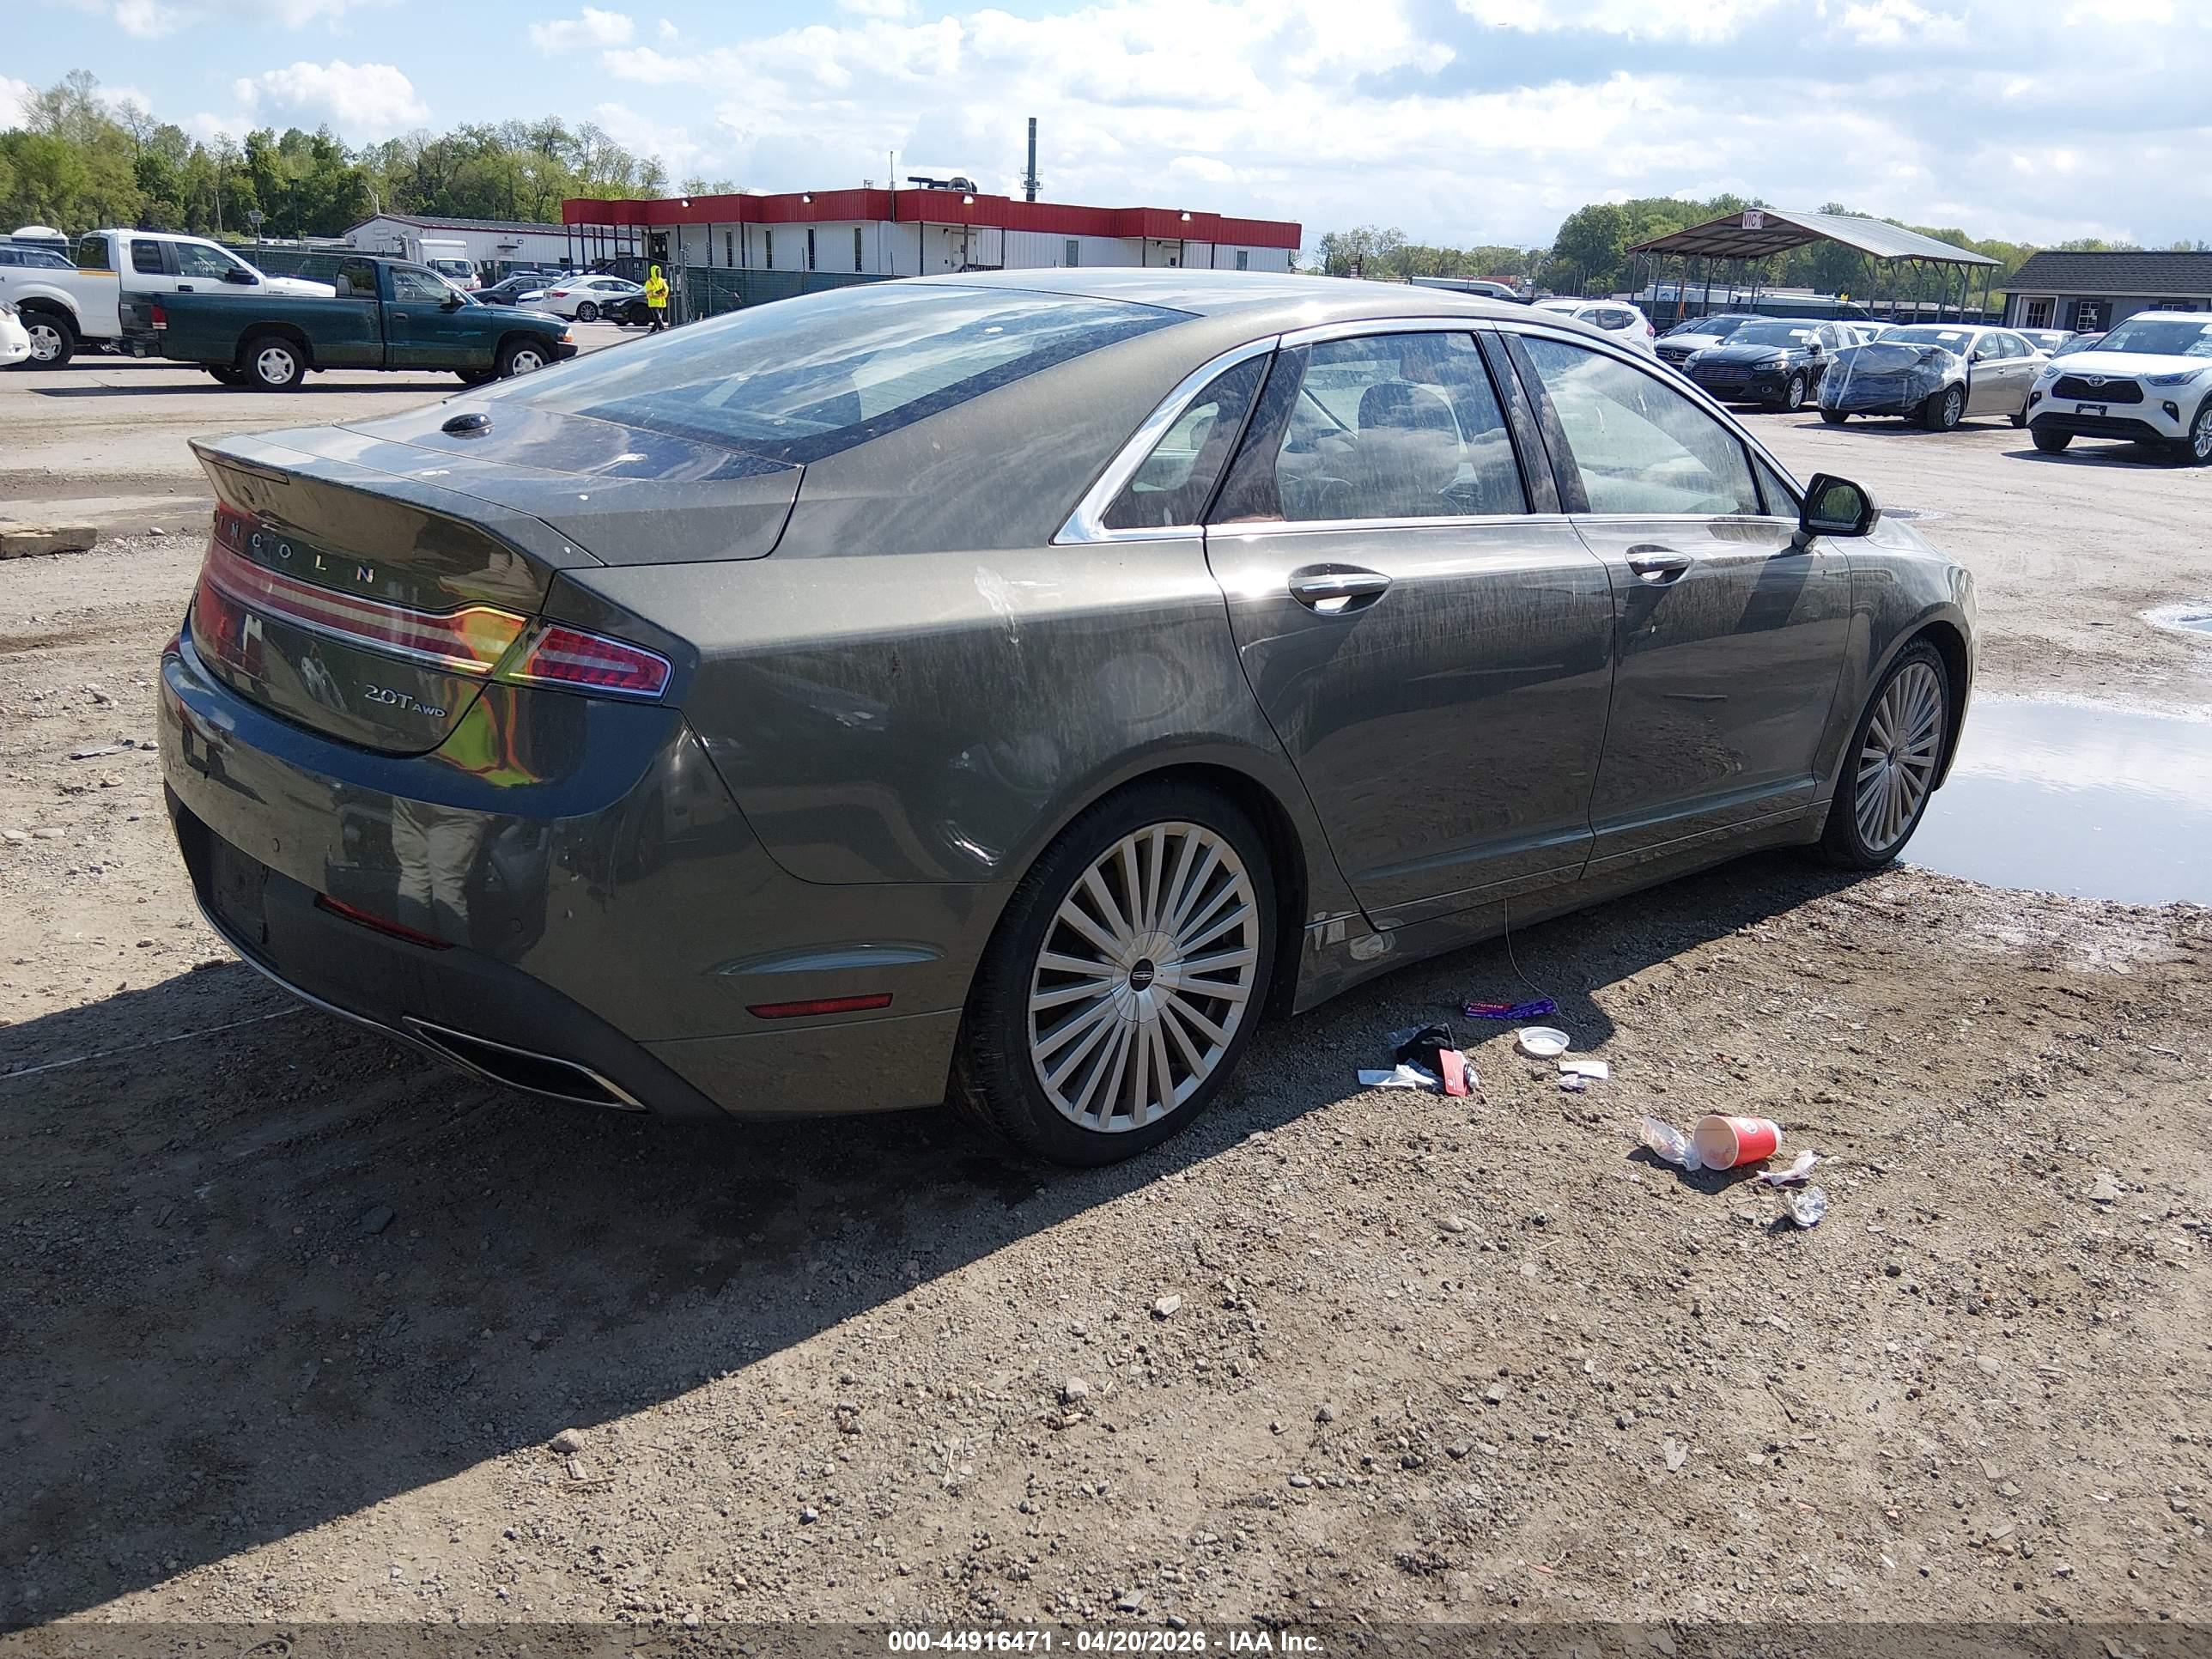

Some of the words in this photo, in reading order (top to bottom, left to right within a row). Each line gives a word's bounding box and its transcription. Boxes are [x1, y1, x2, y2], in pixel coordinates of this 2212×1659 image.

[1744, 214, 1757, 227] VIC
[1758, 214, 1763, 227] 1
[214, 510, 375, 584] INCOLN
[412, 704, 446, 717] AWD
